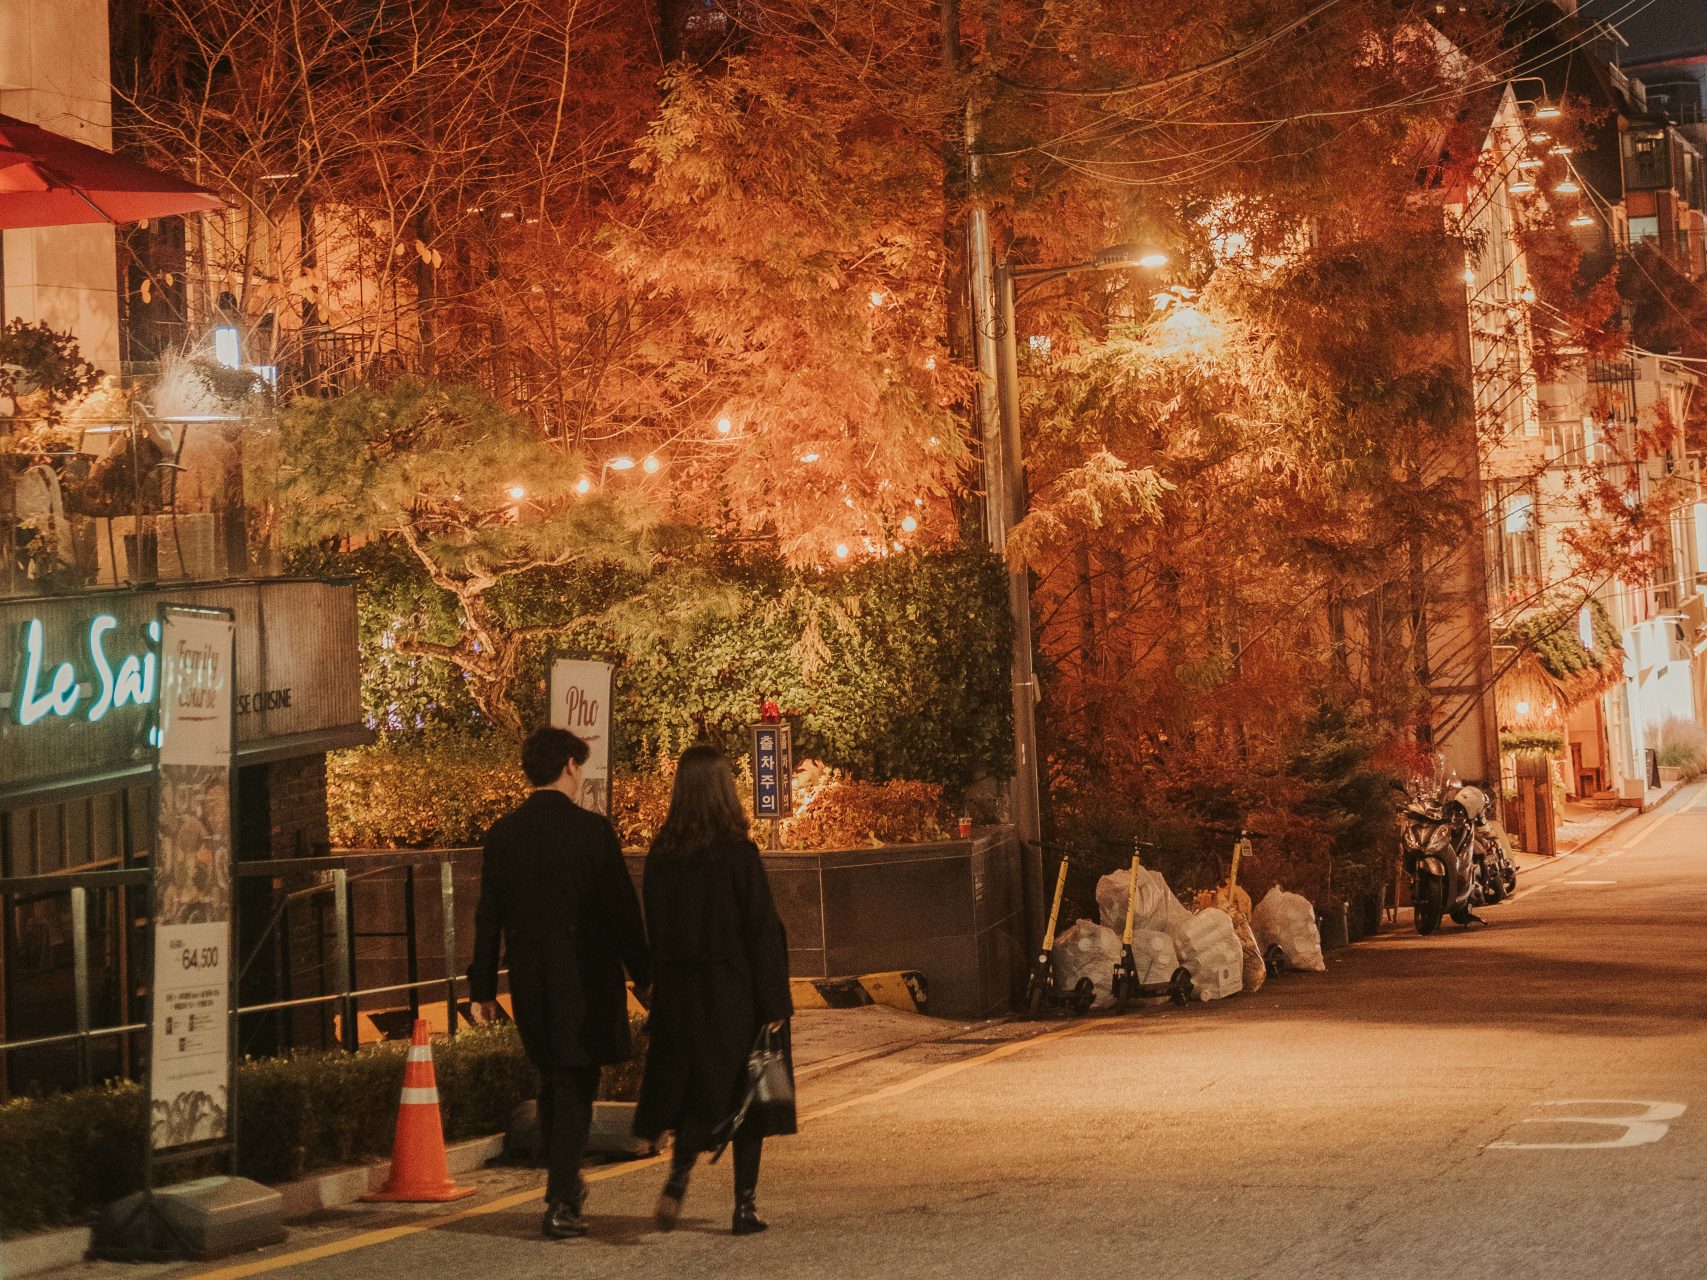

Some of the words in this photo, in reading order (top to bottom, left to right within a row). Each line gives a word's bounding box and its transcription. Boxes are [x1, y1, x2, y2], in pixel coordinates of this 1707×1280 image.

[20, 617, 80, 726] Le
[87, 614, 162, 722] Sai
[176, 639, 219, 680] Family
[177, 682, 217, 710] Course
[236, 693, 251, 716] SE
[253, 687, 292, 713] CUISINE
[565, 685, 600, 727] Pho
[759, 734, 776, 810] 출차주의
[181, 946, 219, 971] 64,500
